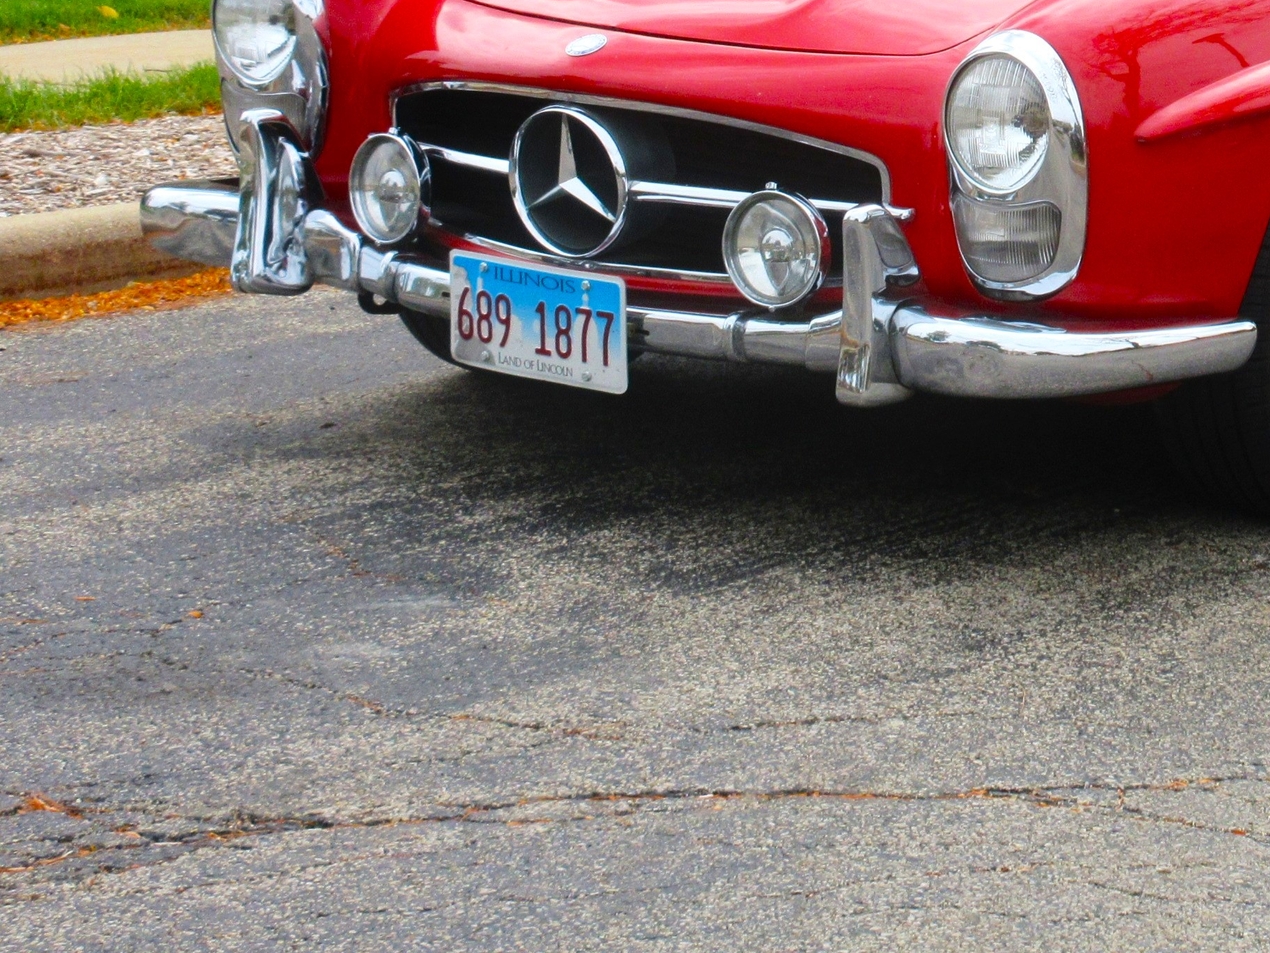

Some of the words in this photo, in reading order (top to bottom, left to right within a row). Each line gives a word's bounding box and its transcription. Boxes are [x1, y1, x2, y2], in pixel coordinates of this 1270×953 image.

[493, 266, 577, 294] ILLINOIS
[457, 287, 512, 348] 689
[534, 301, 615, 367] 1877
